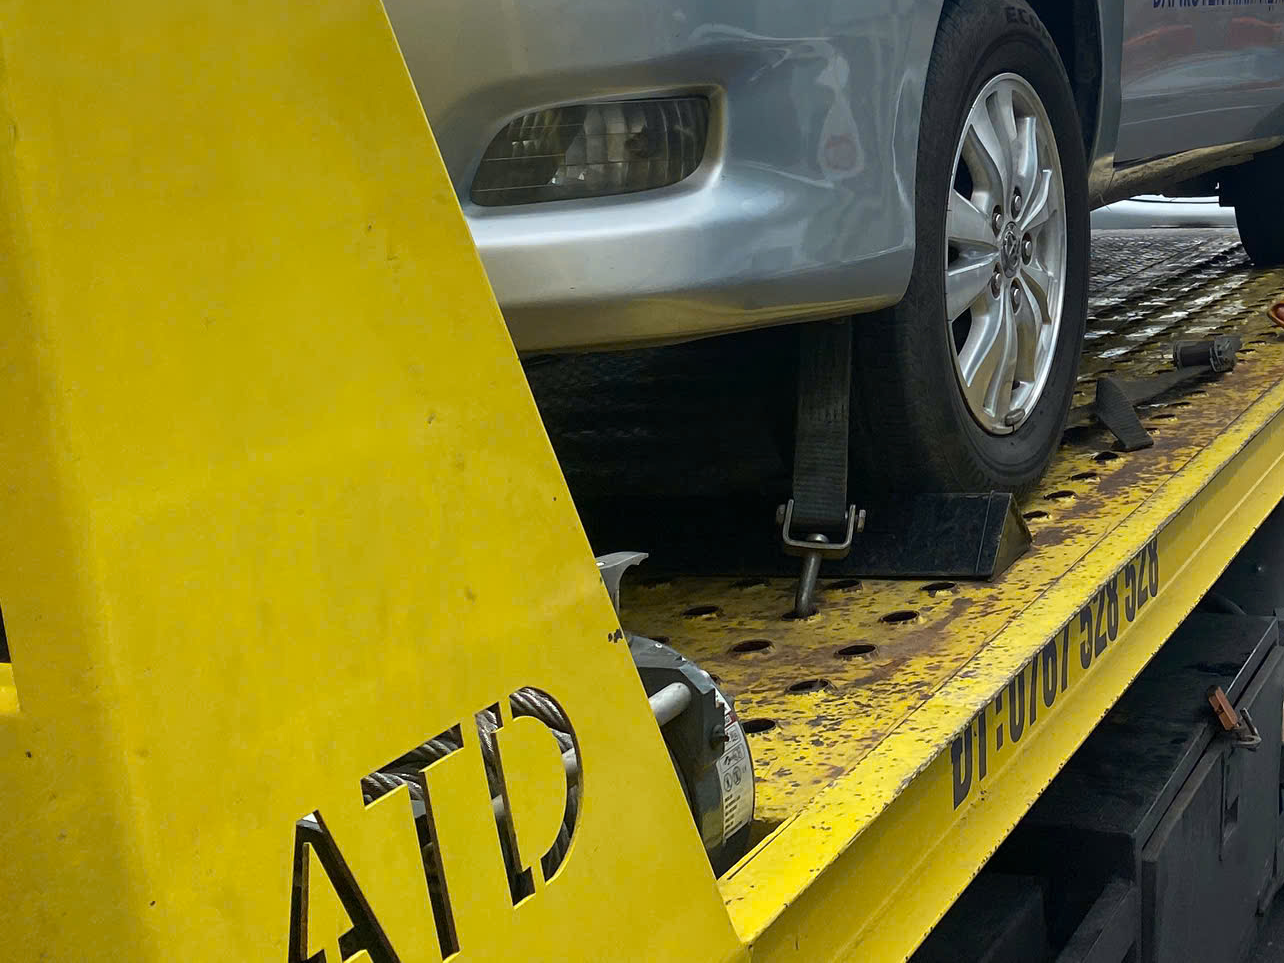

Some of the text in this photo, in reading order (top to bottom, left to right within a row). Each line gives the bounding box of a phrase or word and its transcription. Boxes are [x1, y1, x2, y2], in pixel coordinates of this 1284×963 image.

[1079, 573, 1119, 670] 528
[1124, 536, 1159, 623] 528
[288, 686, 584, 963] ATD
